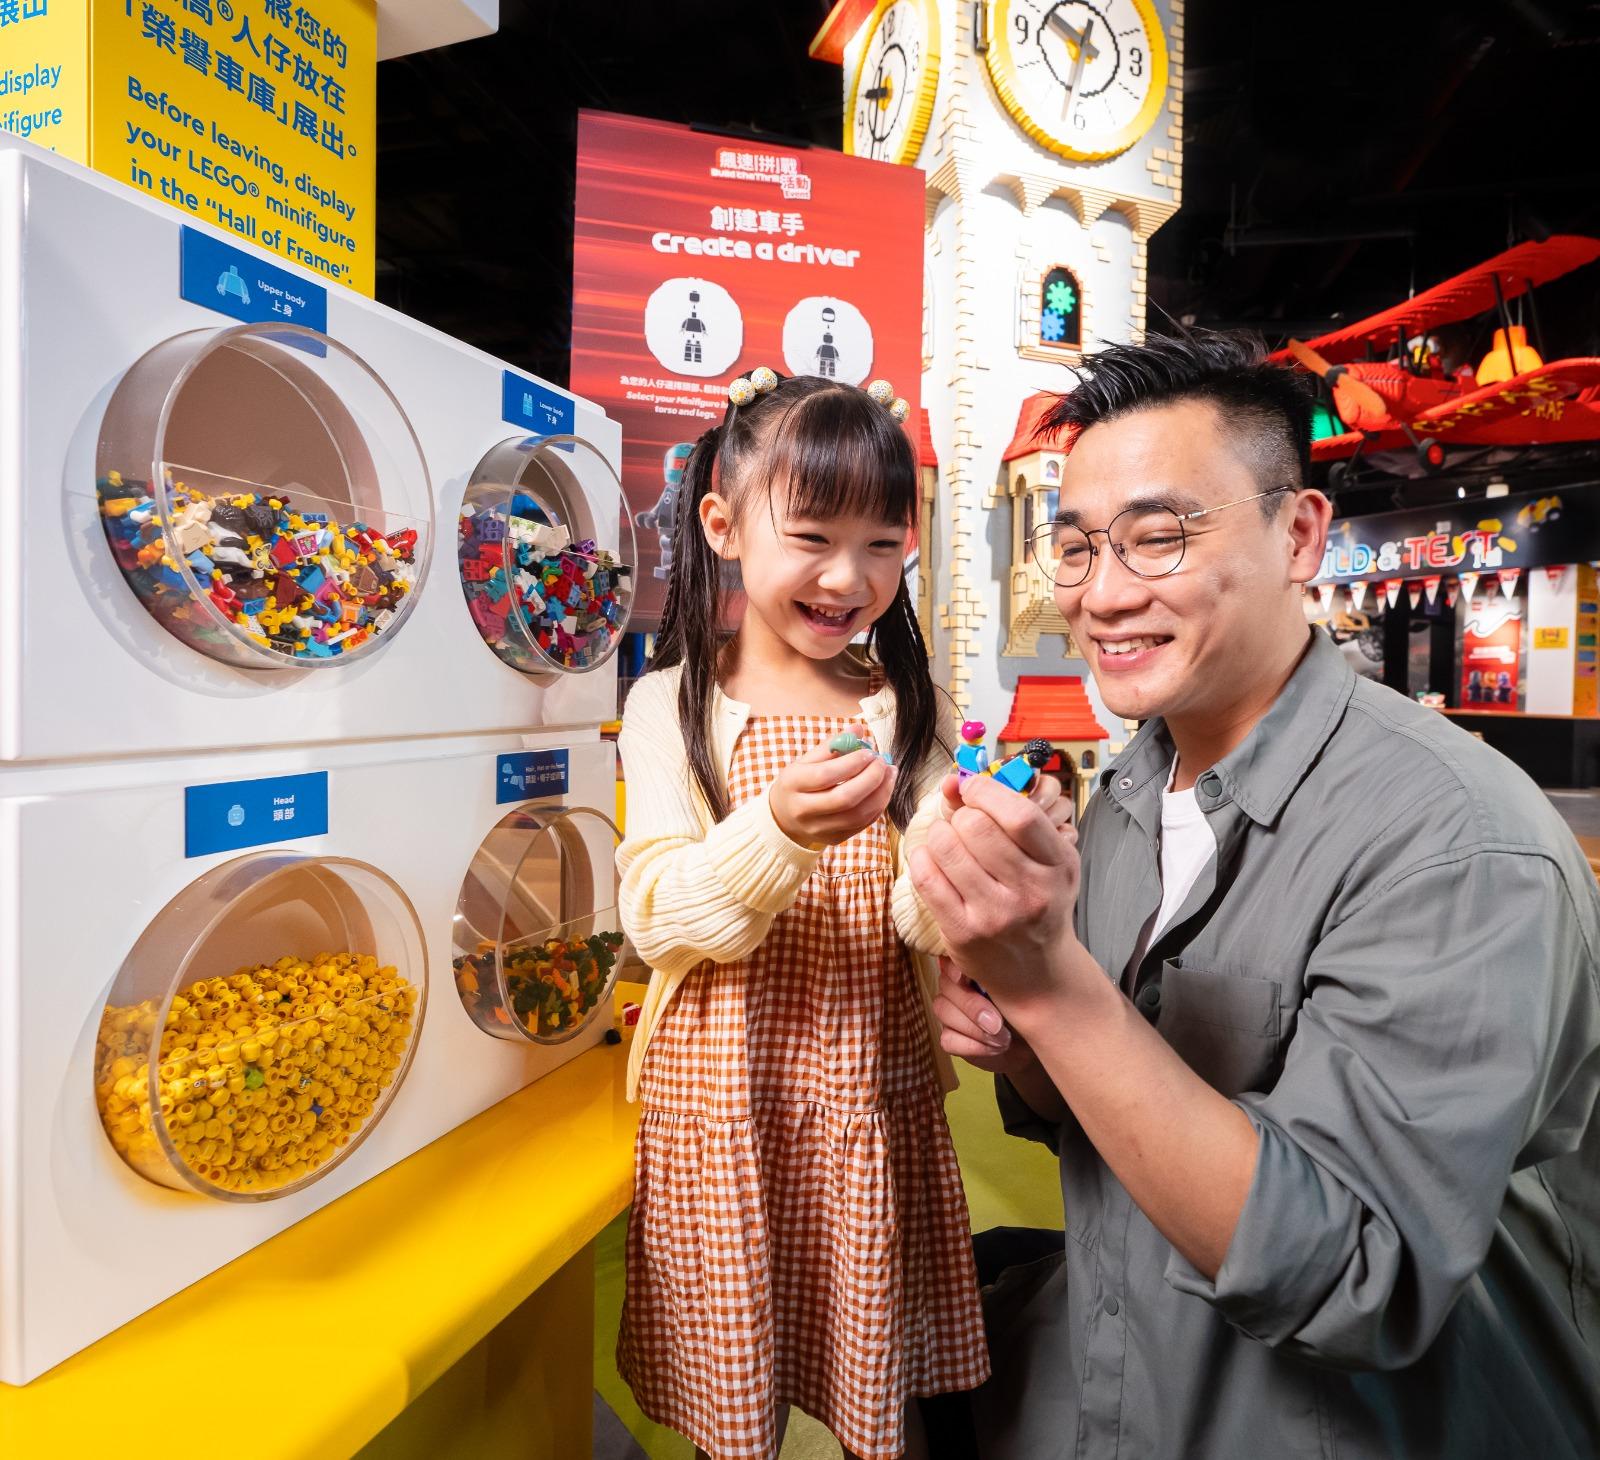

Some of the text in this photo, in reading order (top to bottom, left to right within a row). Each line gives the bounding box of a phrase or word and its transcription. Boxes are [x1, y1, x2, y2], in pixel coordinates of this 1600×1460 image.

[1015, 15, 1028, 45] 9
[1130, 47, 1142, 77] 3
[0, 63, 62, 96] display
[0, 108, 62, 137] ifigure
[128, 75, 356, 221] Before leaving, display
[126, 121, 181, 162] your
[266, 195, 356, 252] minifigure
[131, 158, 153, 190] in
[160, 176, 198, 211] the
[262, 230, 281, 250] of
[710, 206, 805, 237] 創建車手
[652, 232, 861, 267] Create a driver
[257, 279, 306, 308] Upper body
[271, 299, 293, 317] 上身
[626, 391, 655, 402] Select
[655, 395, 676, 404] your
[676, 396, 721, 409] Minifigure
[655, 406, 717, 420] torso and legs.
[1377, 541, 1401, 571] &
[273, 795, 295, 806] Head
[273, 807, 295, 821] 頭部
